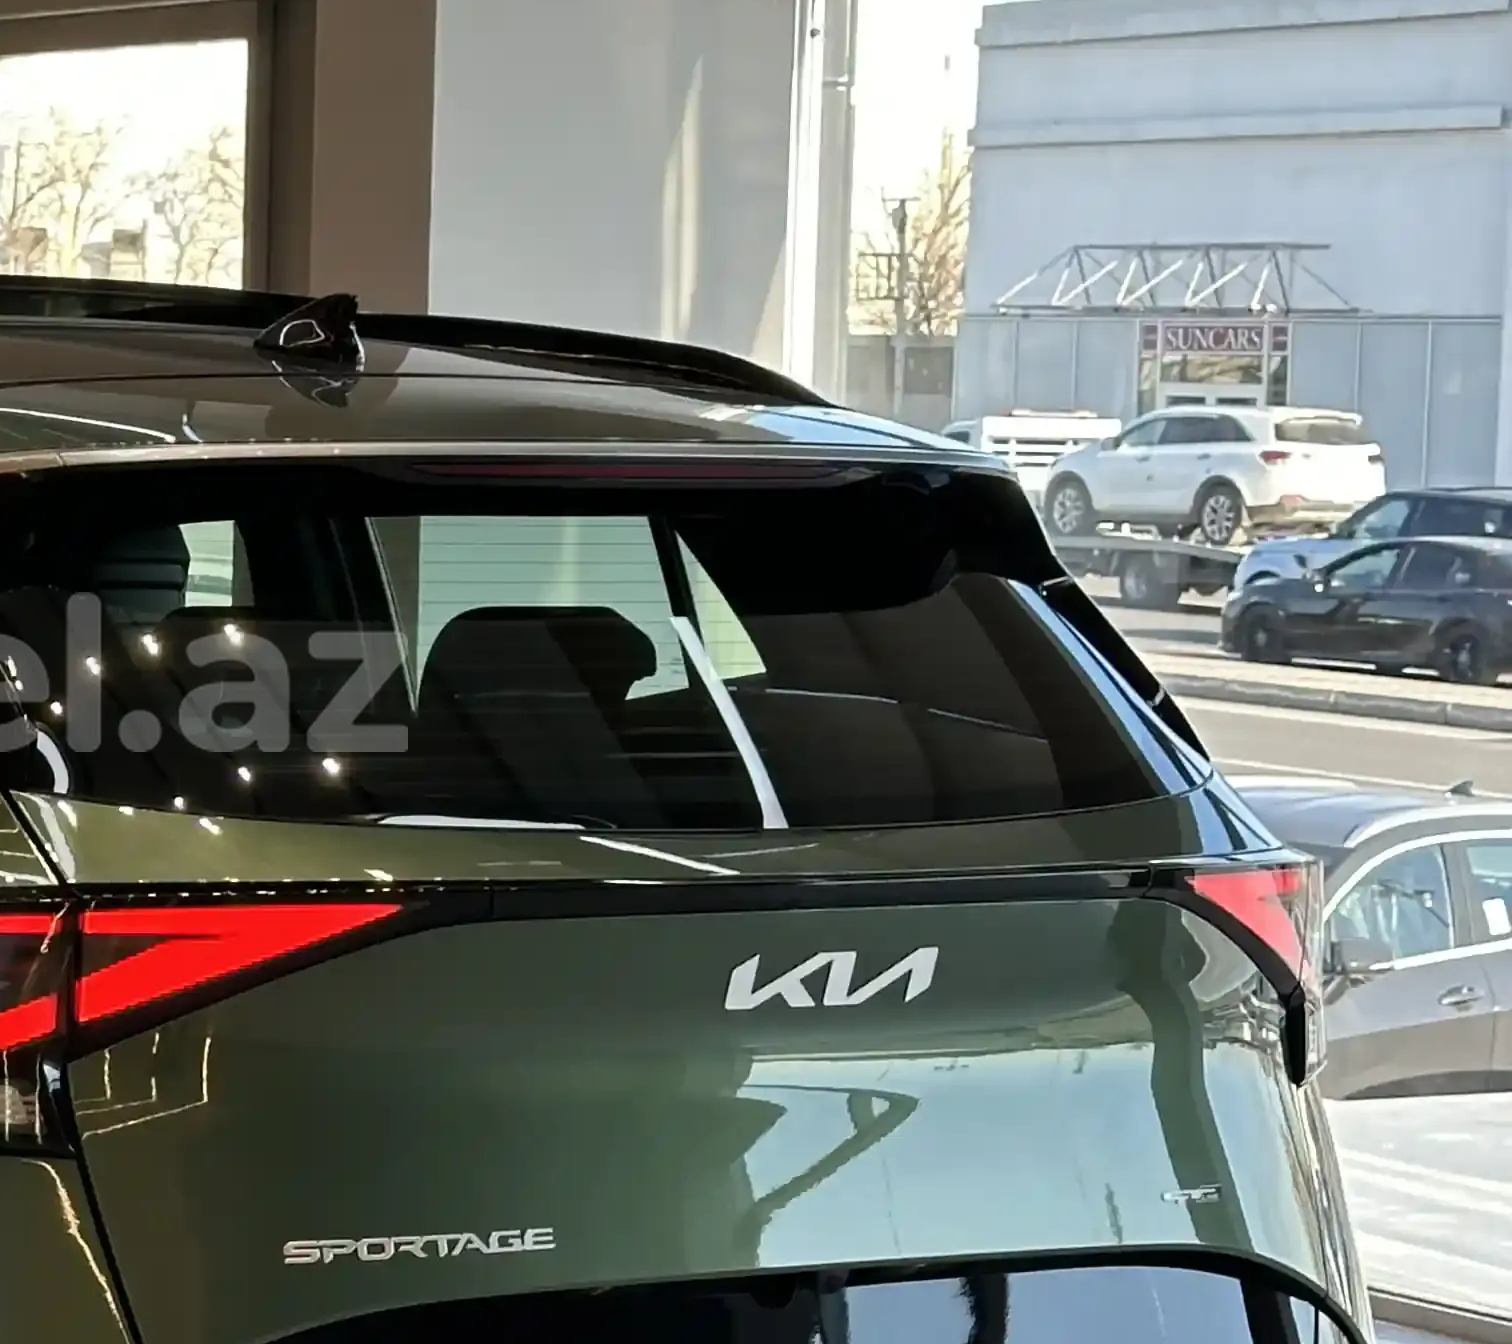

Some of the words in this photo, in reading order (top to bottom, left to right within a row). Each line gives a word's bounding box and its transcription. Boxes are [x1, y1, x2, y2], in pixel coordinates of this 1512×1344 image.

[1166, 327, 1262, 350] SUNCARS
[724, 945, 940, 1011] KIA
[283, 1227, 557, 1265] SPORTAGE
